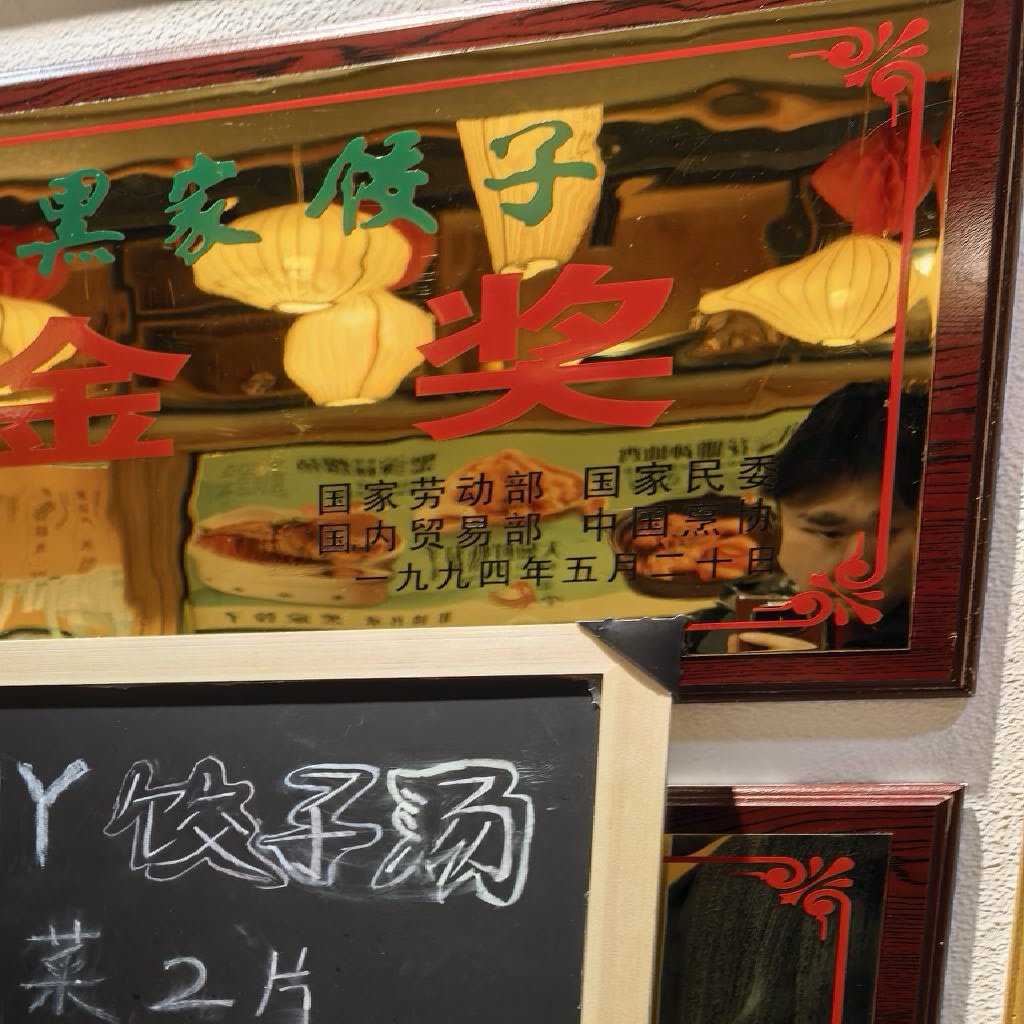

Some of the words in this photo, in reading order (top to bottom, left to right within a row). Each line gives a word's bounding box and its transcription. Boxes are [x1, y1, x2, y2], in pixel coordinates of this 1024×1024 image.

[318, 467, 545, 516] 国家劳动部
[584, 454, 777, 501] 国家民委
[318, 511, 543, 556] 国内贸易部
[583, 497, 774, 541] 中国烹协
[356, 546, 777, 592] 一九九四年五月二十日
[103, 755, 536, 907] 饺子汤
